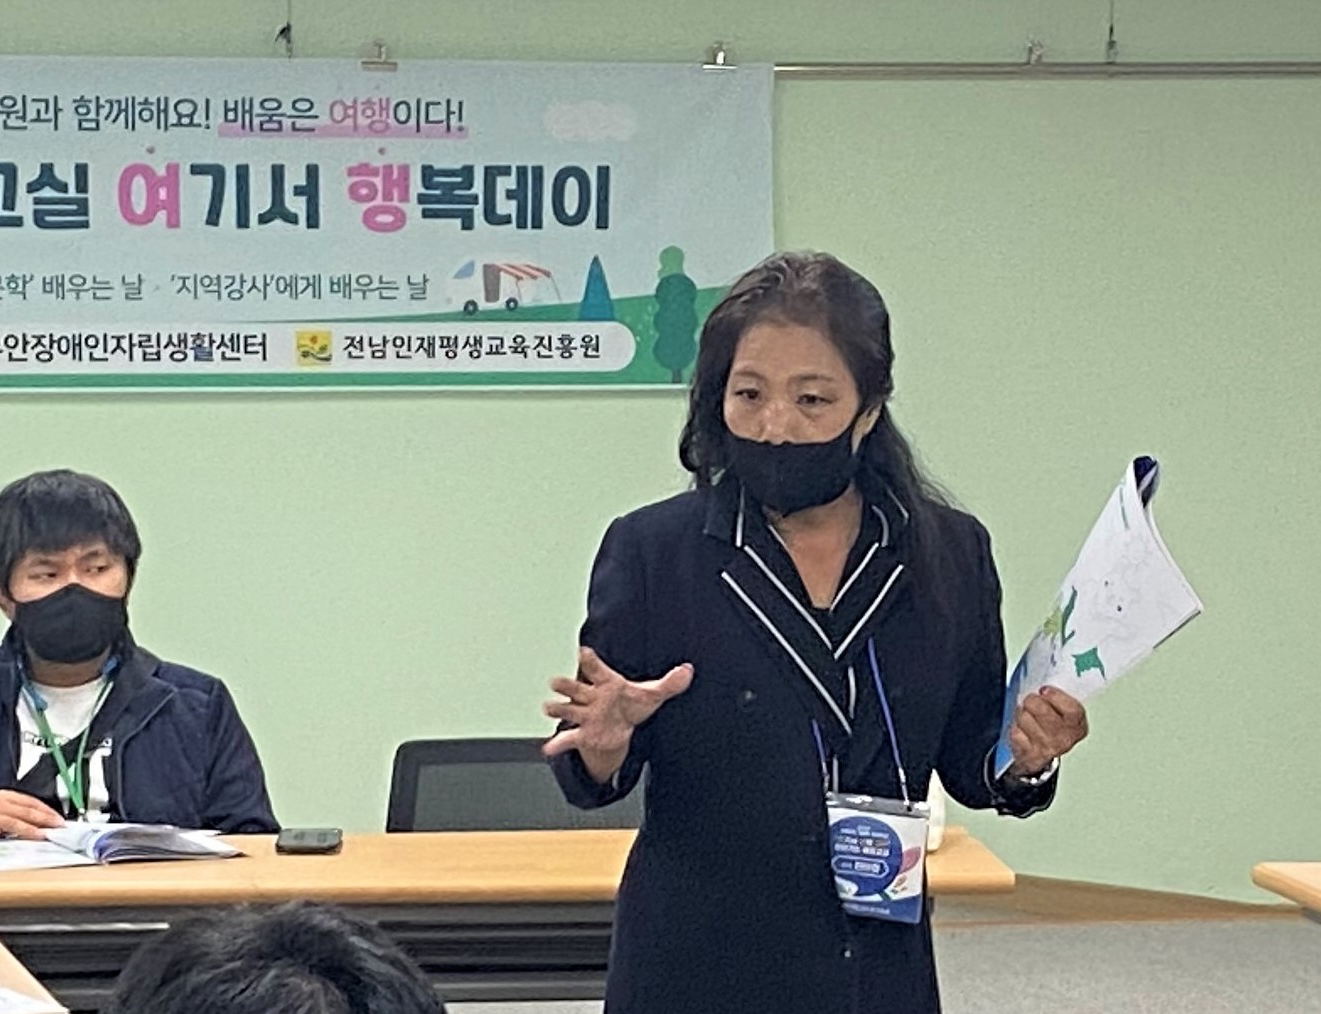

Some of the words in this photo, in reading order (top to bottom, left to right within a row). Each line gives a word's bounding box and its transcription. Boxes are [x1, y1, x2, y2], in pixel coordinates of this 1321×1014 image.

[72, 94, 211, 132] 함께해요!
[223, 96, 320, 133] 배움은
[330, 97, 465, 134] 여행이다!
[117, 161, 320, 230] 여기서
[346, 163, 611, 232] 행복데이
[42, 273, 115, 301] 배우는
[121, 273, 143, 301] 날
[328, 273, 400, 301] 배우는
[406, 273, 430, 301] 날
[343, 333, 600, 360] 전남인재평생교육진흥원
